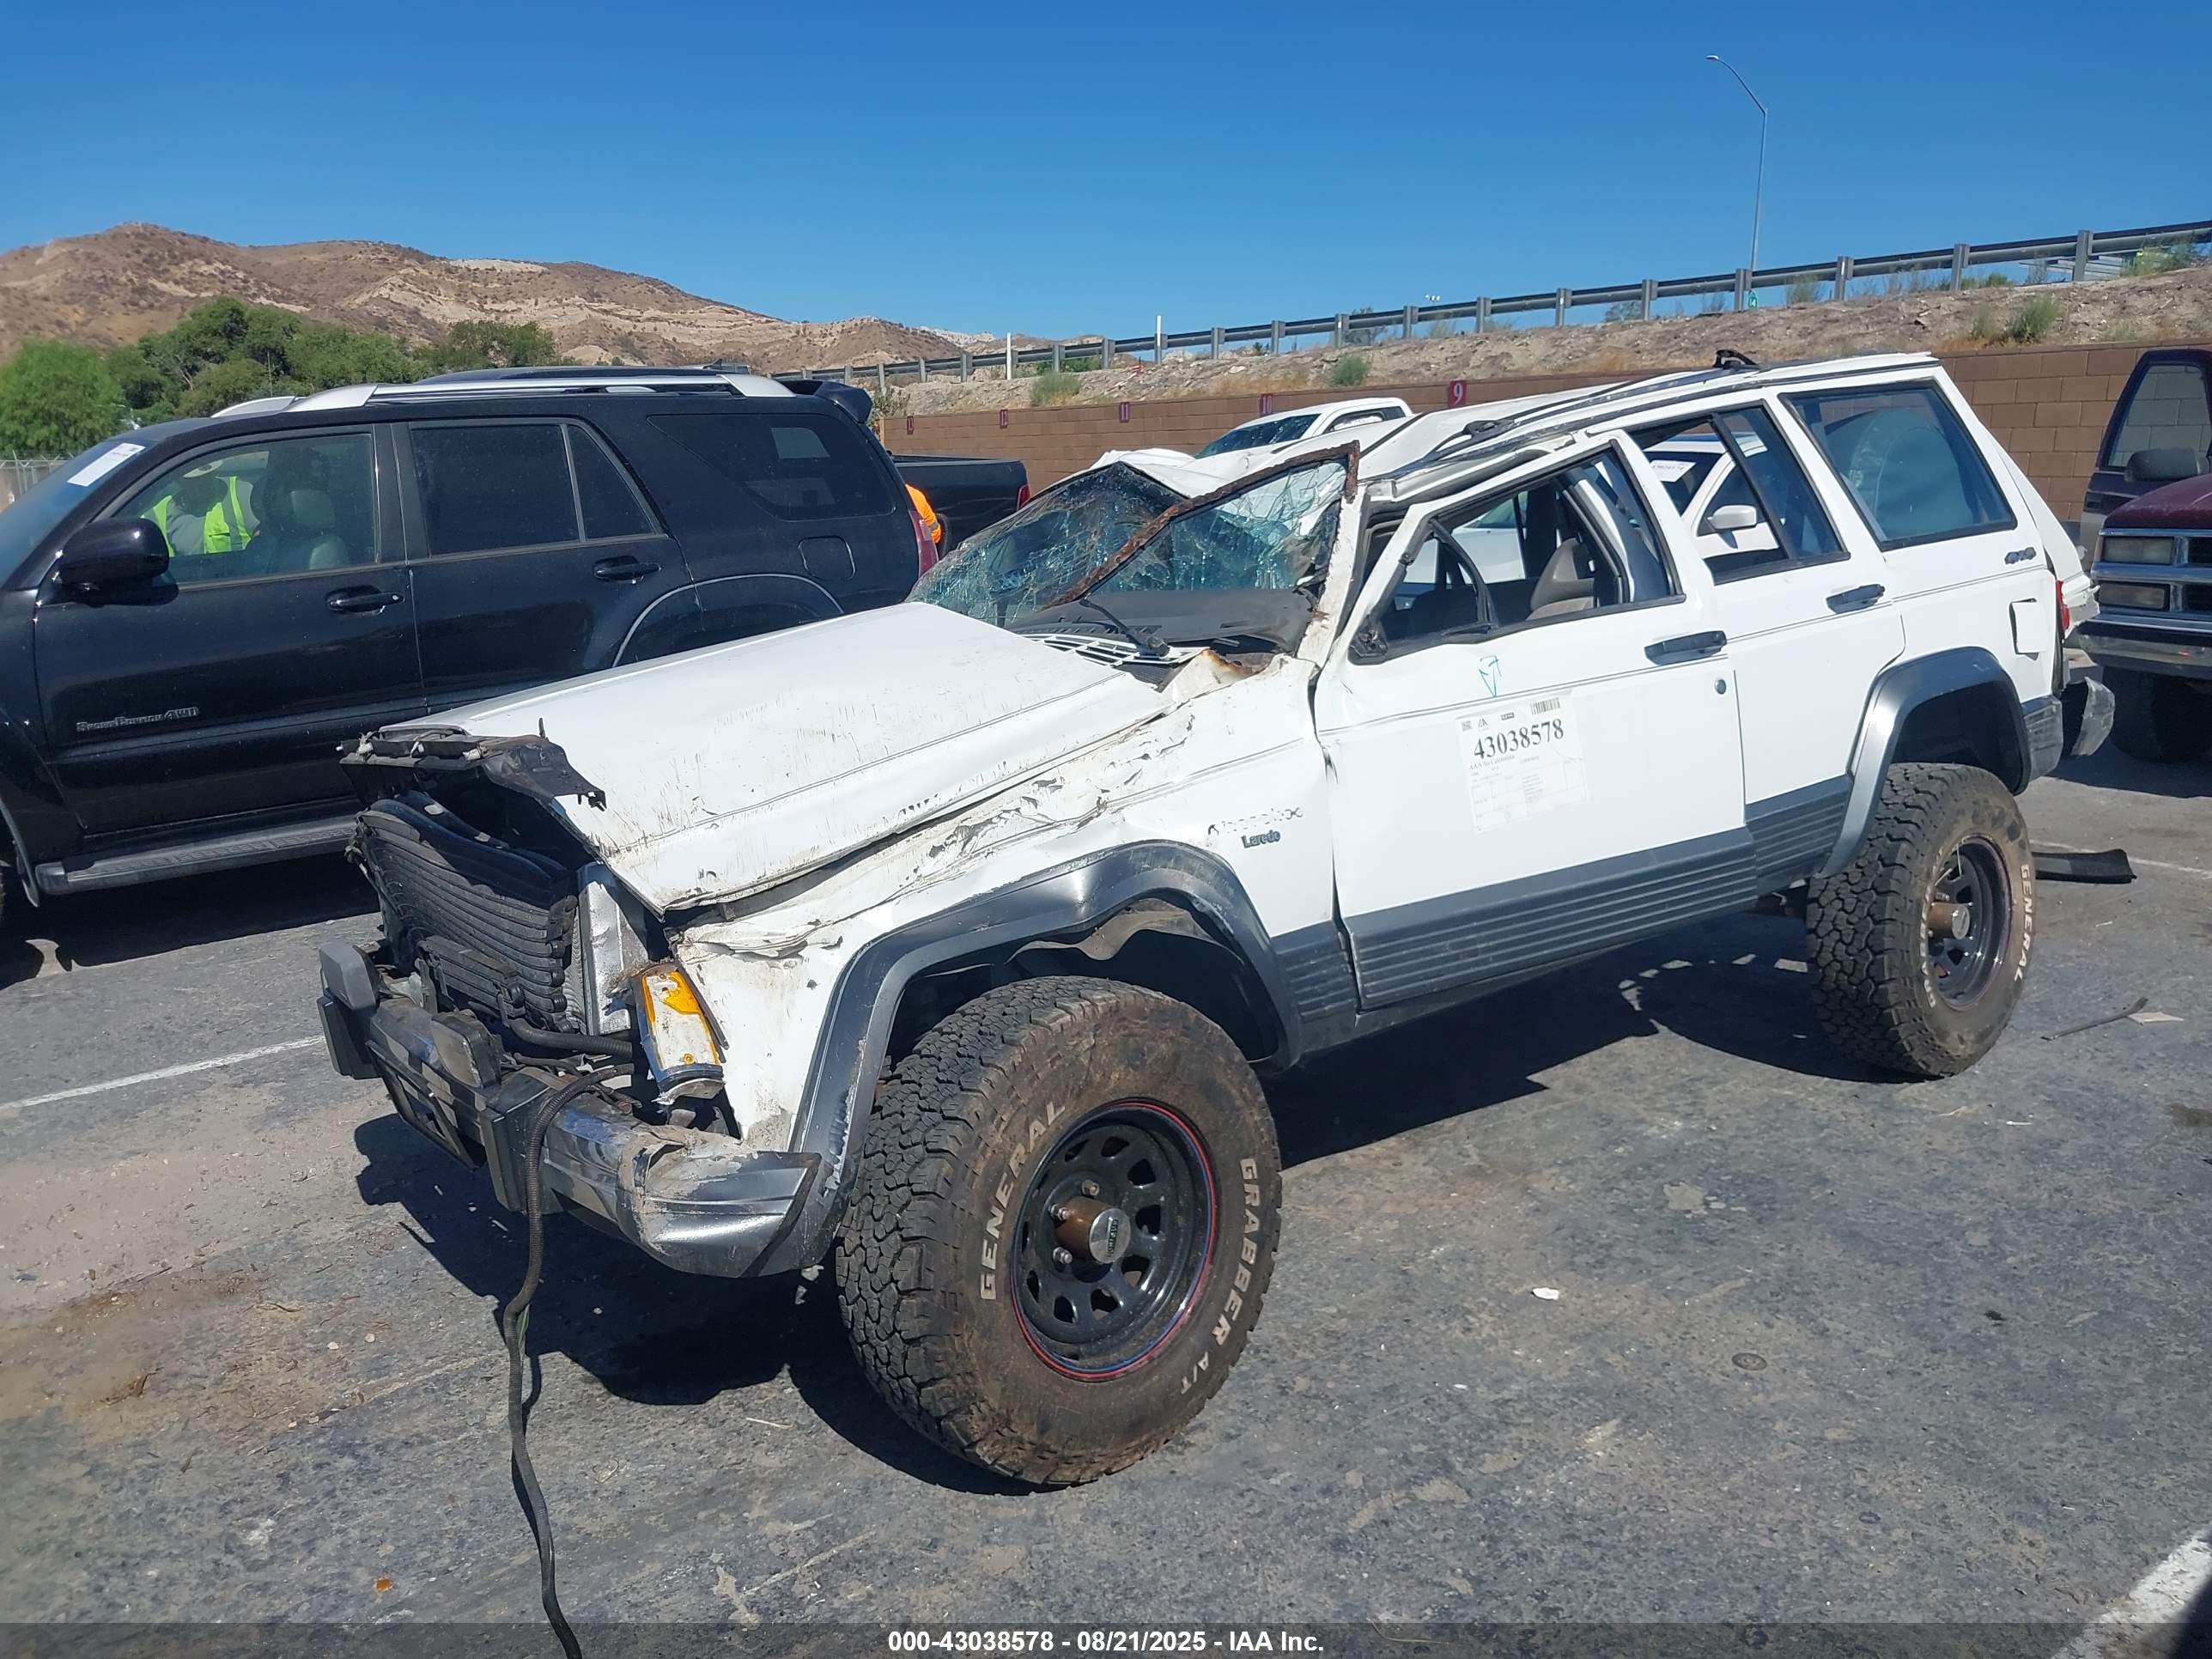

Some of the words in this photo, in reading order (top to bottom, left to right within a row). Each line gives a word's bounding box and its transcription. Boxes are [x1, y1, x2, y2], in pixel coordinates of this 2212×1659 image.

[1261, 395, 1273, 414] 10
[1453, 382, 1465, 404] 9
[164, 707, 199, 721] 4WD
[1474, 718, 1565, 759] 43038578
[1241, 830, 1281, 848] Laredo
[2013, 863, 2034, 982] GENERAL
[980, 1100, 1066, 1301] GENERAL
[1211, 1158, 1261, 1346] GRABBER
[1180, 1351, 1210, 1395] A/T
